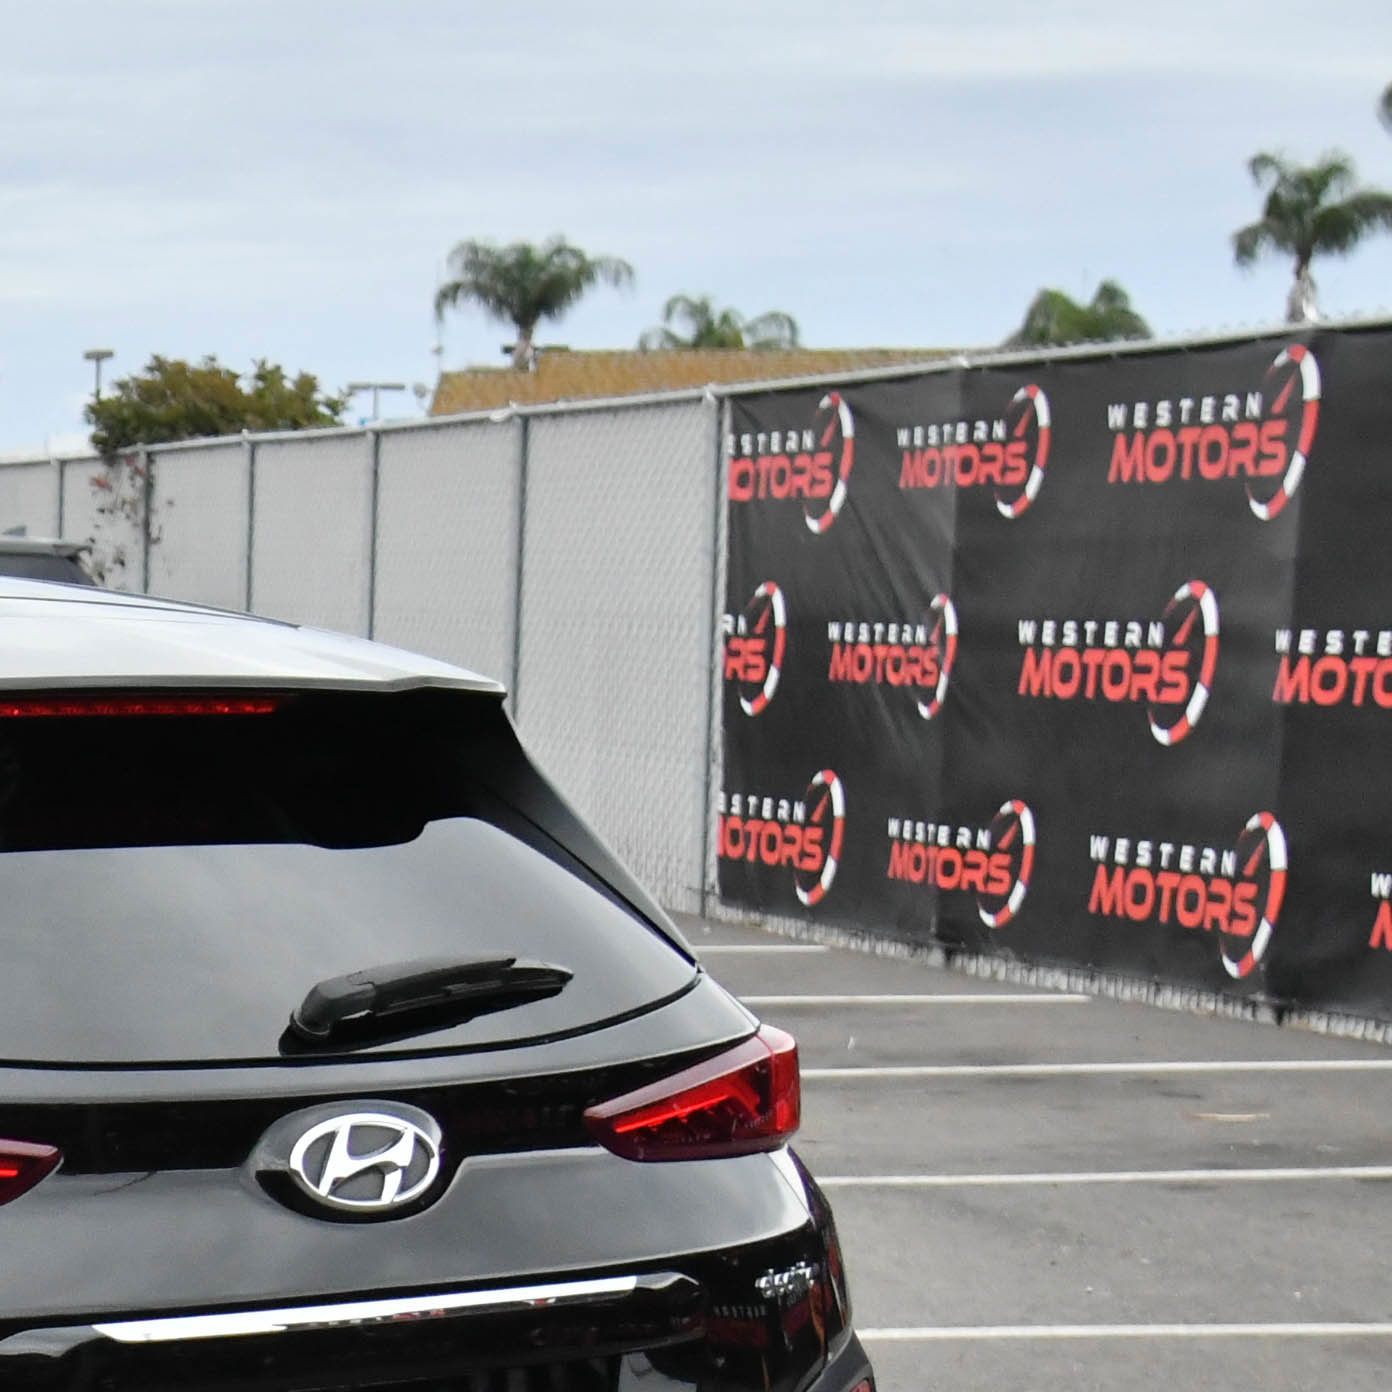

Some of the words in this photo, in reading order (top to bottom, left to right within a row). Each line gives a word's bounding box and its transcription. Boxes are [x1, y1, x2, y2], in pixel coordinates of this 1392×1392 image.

[897, 419, 1006, 448] WESTERN
[1107, 391, 1263, 430] WESTERN
[898, 441, 1028, 489] MOTORS
[1107, 418, 1288, 484] MOTORS
[728, 452, 833, 501] OTORS
[828, 621, 927, 645] WESTERN
[1018, 619, 1164, 648] WESTERN
[828, 641, 940, 687] MOTORS
[1018, 647, 1190, 704] MOTORS
[888, 816, 991, 851] WESTERN
[1090, 833, 1237, 878] WESTERN
[888, 840, 1013, 895] MOTORS
[1088, 863, 1258, 936] MOTORS
